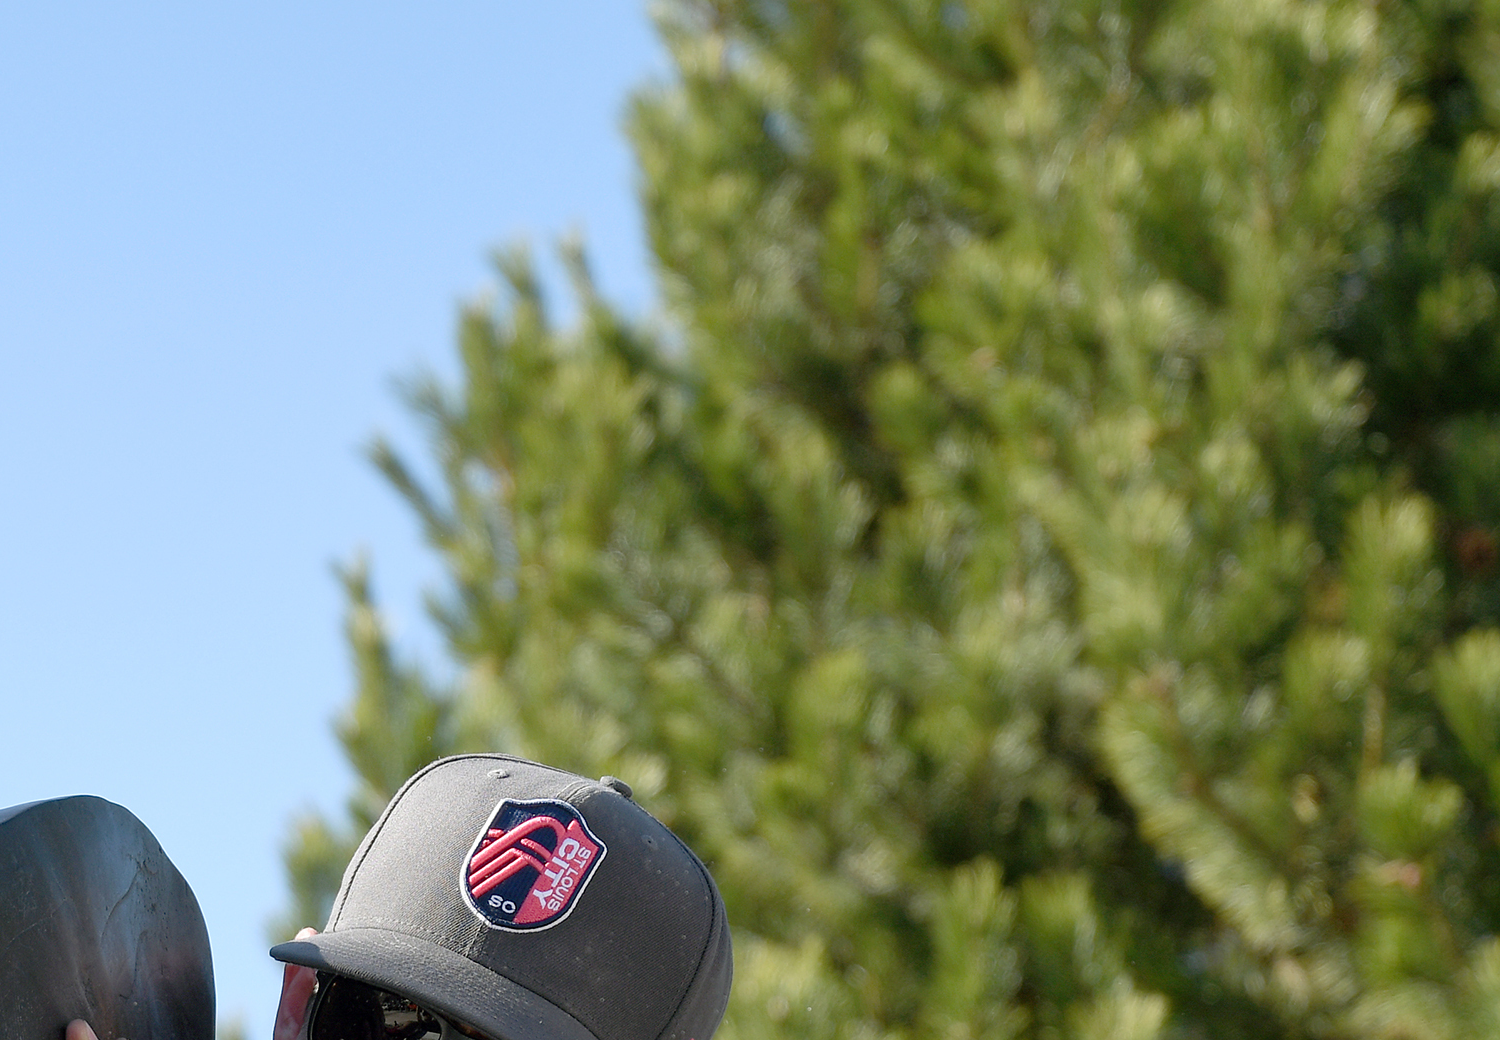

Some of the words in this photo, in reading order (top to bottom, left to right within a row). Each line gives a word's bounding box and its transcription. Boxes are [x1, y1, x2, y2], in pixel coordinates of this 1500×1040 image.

[533, 837, 580, 910] CITY
[574, 846, 592, 869] ST
[546, 865, 579, 911] LOUIS
